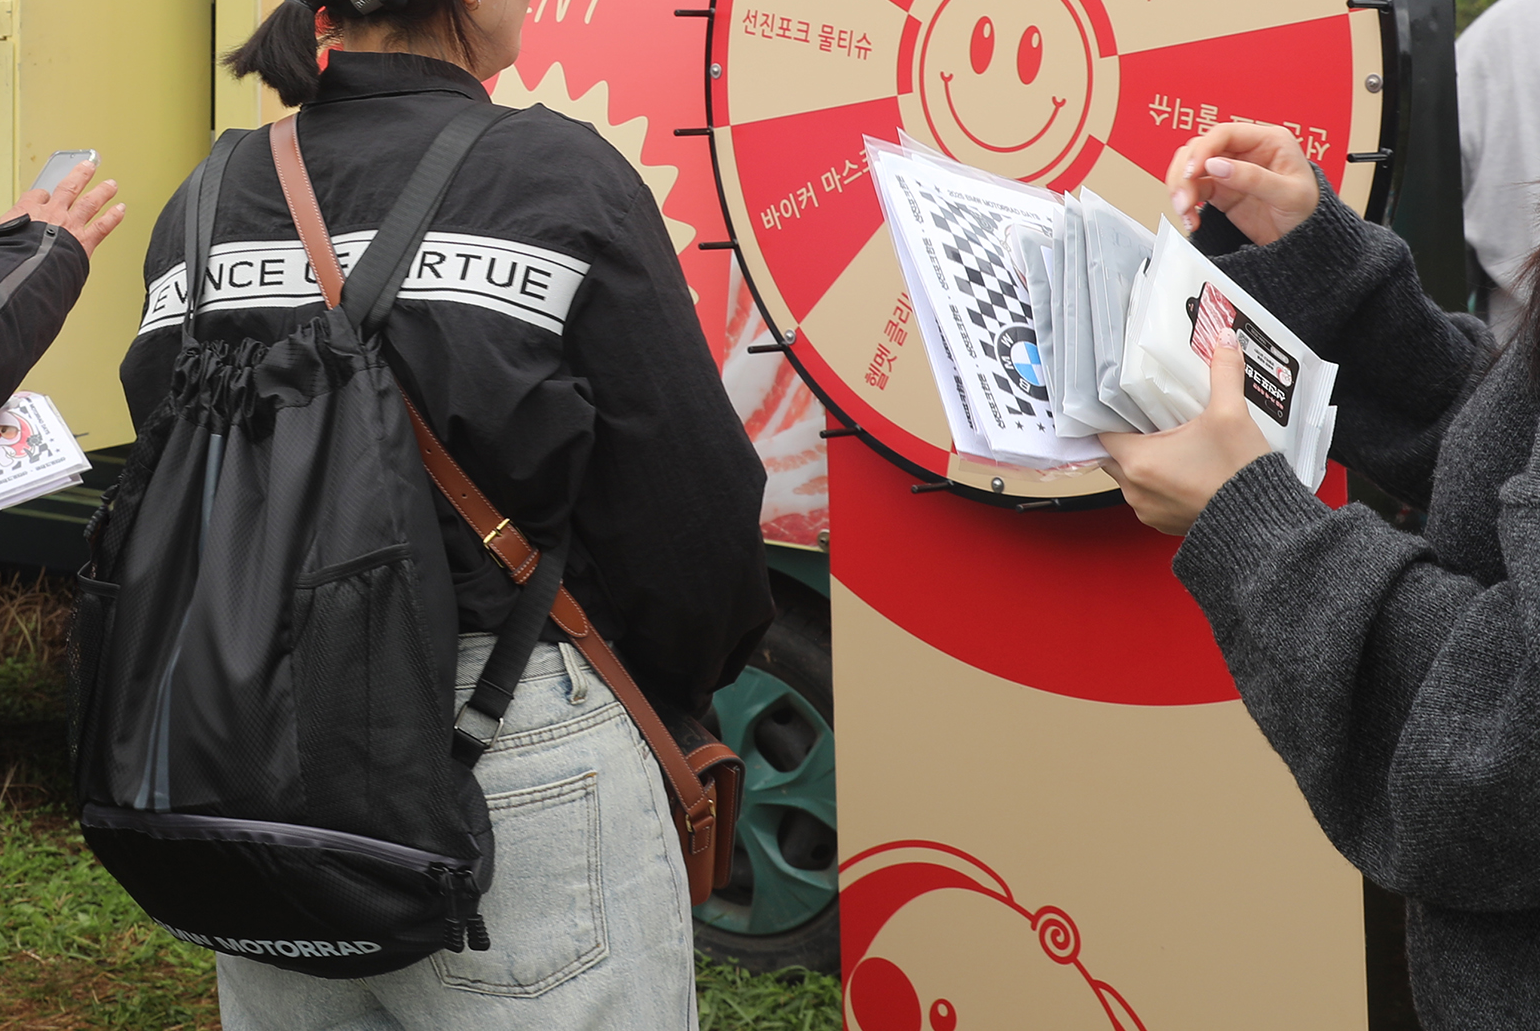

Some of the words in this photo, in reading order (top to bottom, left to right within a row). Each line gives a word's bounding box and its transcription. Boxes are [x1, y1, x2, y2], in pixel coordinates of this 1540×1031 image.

[743, 9, 810, 43] 선진포크
[818, 24, 872, 60] 물티슈
[761, 182, 819, 230] 바이커
[864, 343, 897, 391] 헬멧
[884, 292, 913, 347] 클리
[213, 936, 382, 958] MOTORRAD
